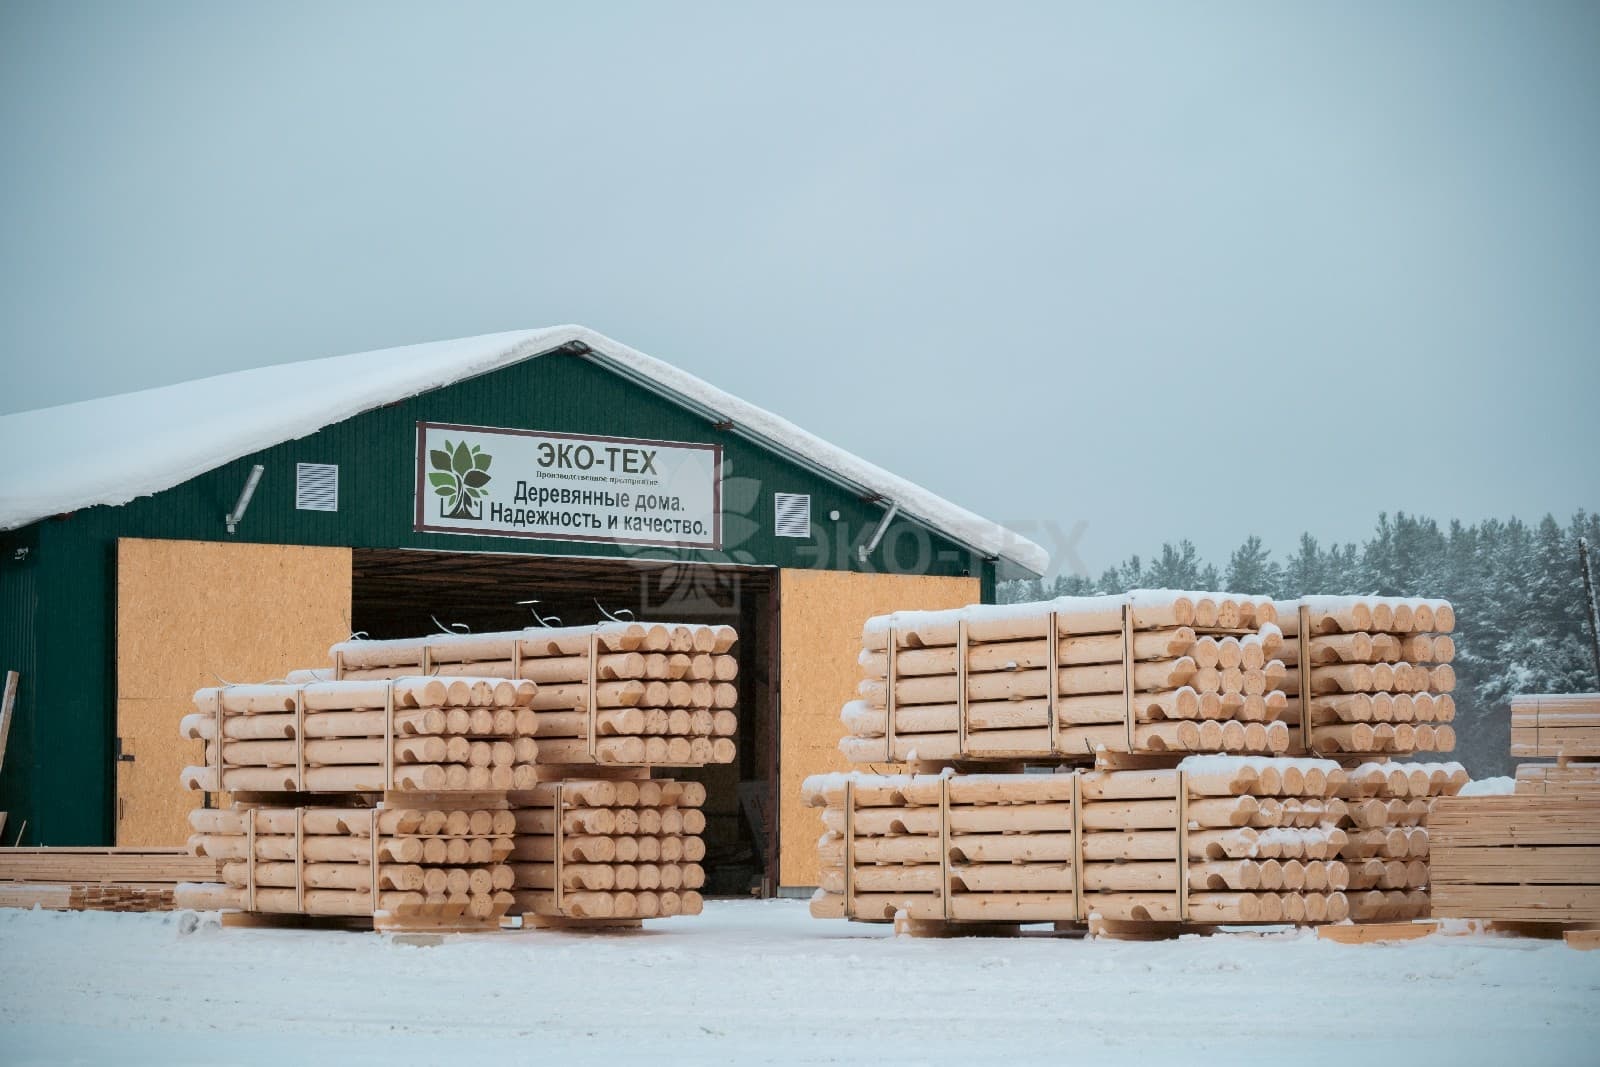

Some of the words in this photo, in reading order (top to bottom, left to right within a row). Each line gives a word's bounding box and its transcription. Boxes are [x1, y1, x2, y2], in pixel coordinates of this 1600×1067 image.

[537, 442, 658, 475] ЭКО-ТЕХ
[514, 481, 629, 507] Деревянные
[635, 493, 685, 512] дома.
[490, 502, 601, 528] Надежность
[607, 515, 618, 530] и
[624, 517, 708, 536] качество.
